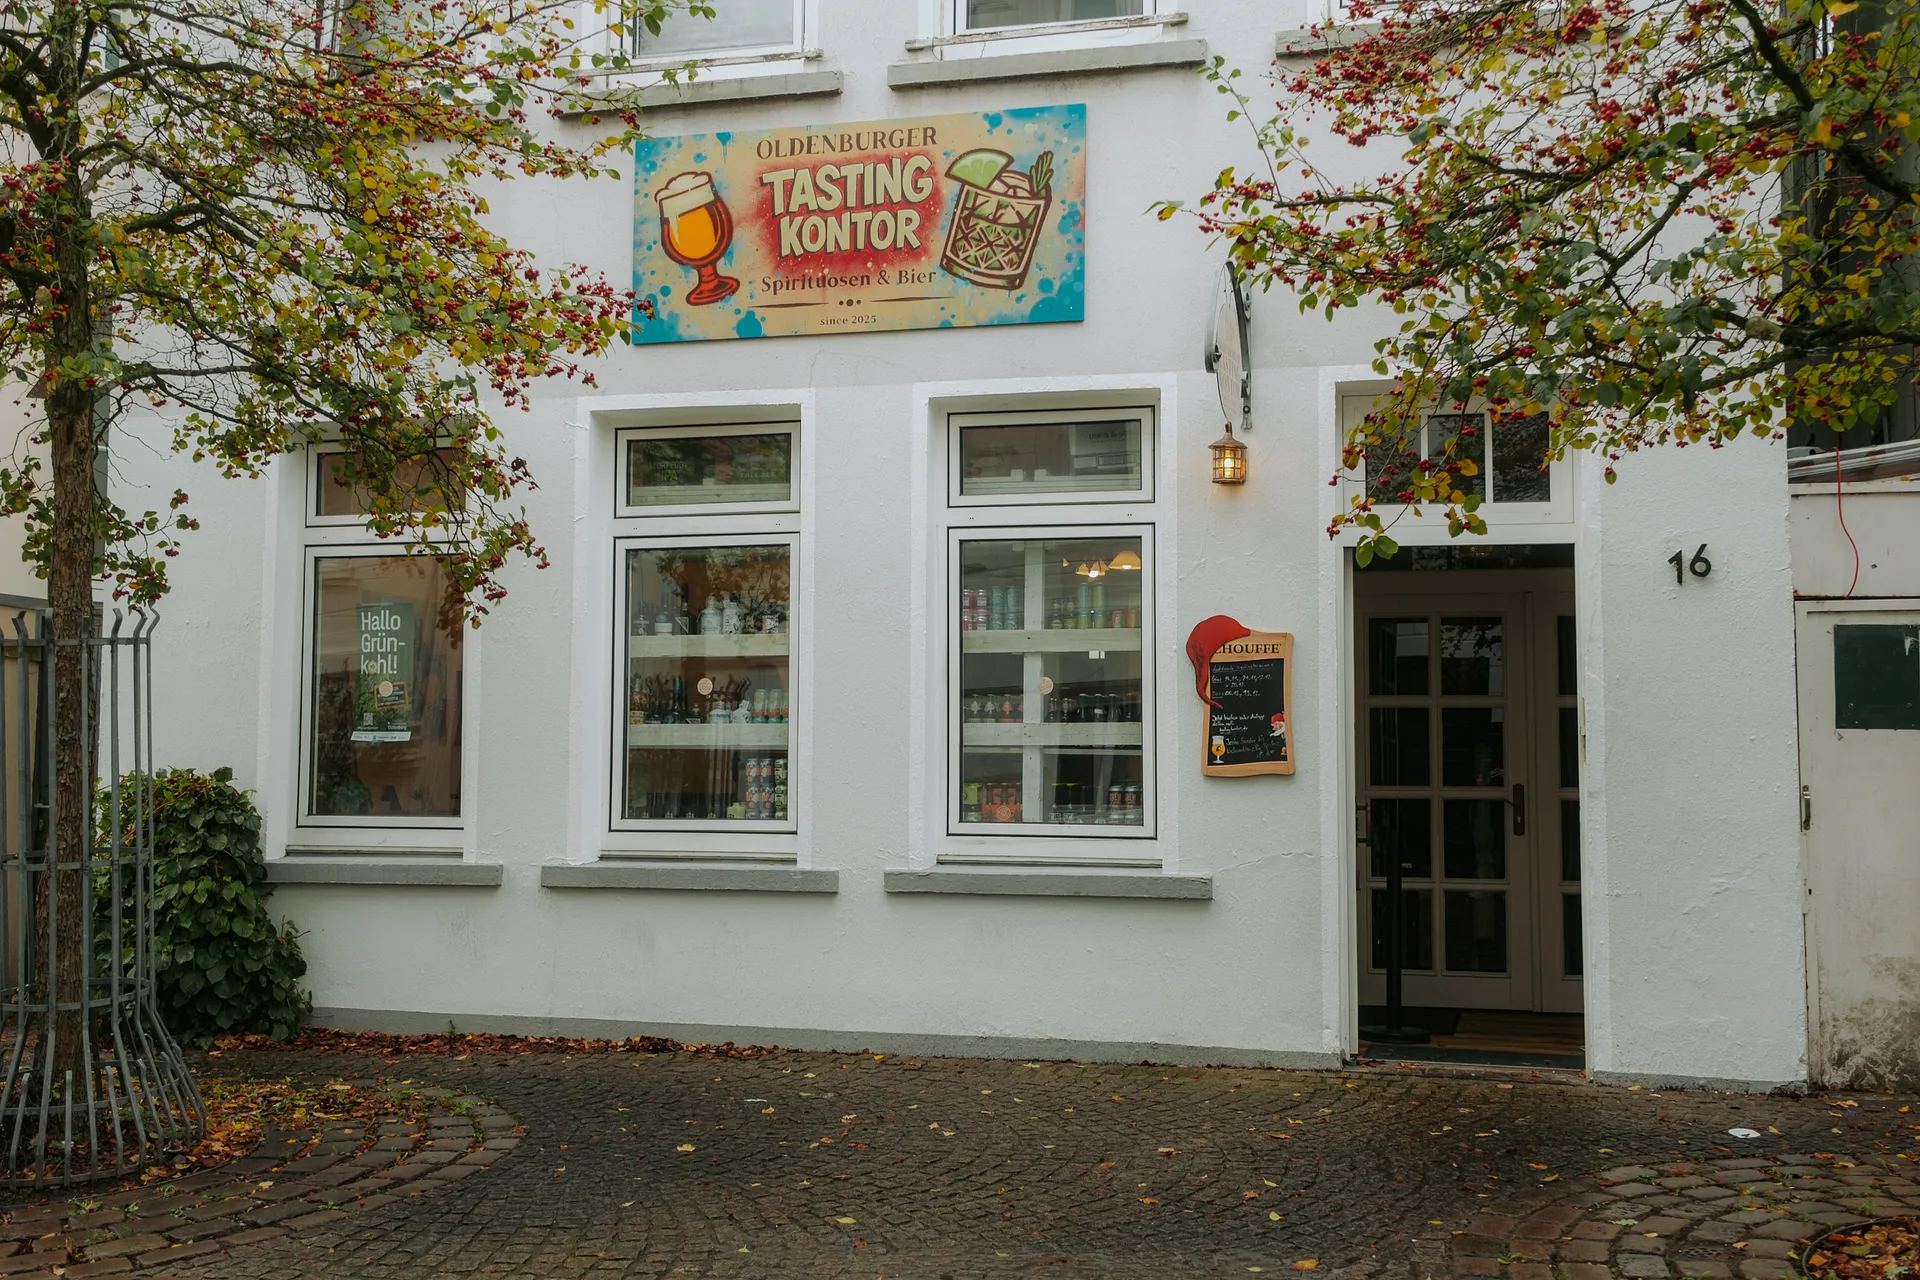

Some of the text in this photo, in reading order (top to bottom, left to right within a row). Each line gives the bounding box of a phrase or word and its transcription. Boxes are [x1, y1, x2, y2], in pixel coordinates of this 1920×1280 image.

[756, 126, 937, 159] OLDENBURGER
[760, 154, 934, 218] TASTING
[778, 208, 922, 259] KONTOR
[761, 268, 937, 295] Spirituosen & Bier
[820, 315, 877, 325] since 2025
[1668, 543, 1711, 585] 16
[361, 610, 401, 630] Hallo
[361, 633, 405, 652] Grün-
[360, 654, 397, 674] kohl!
